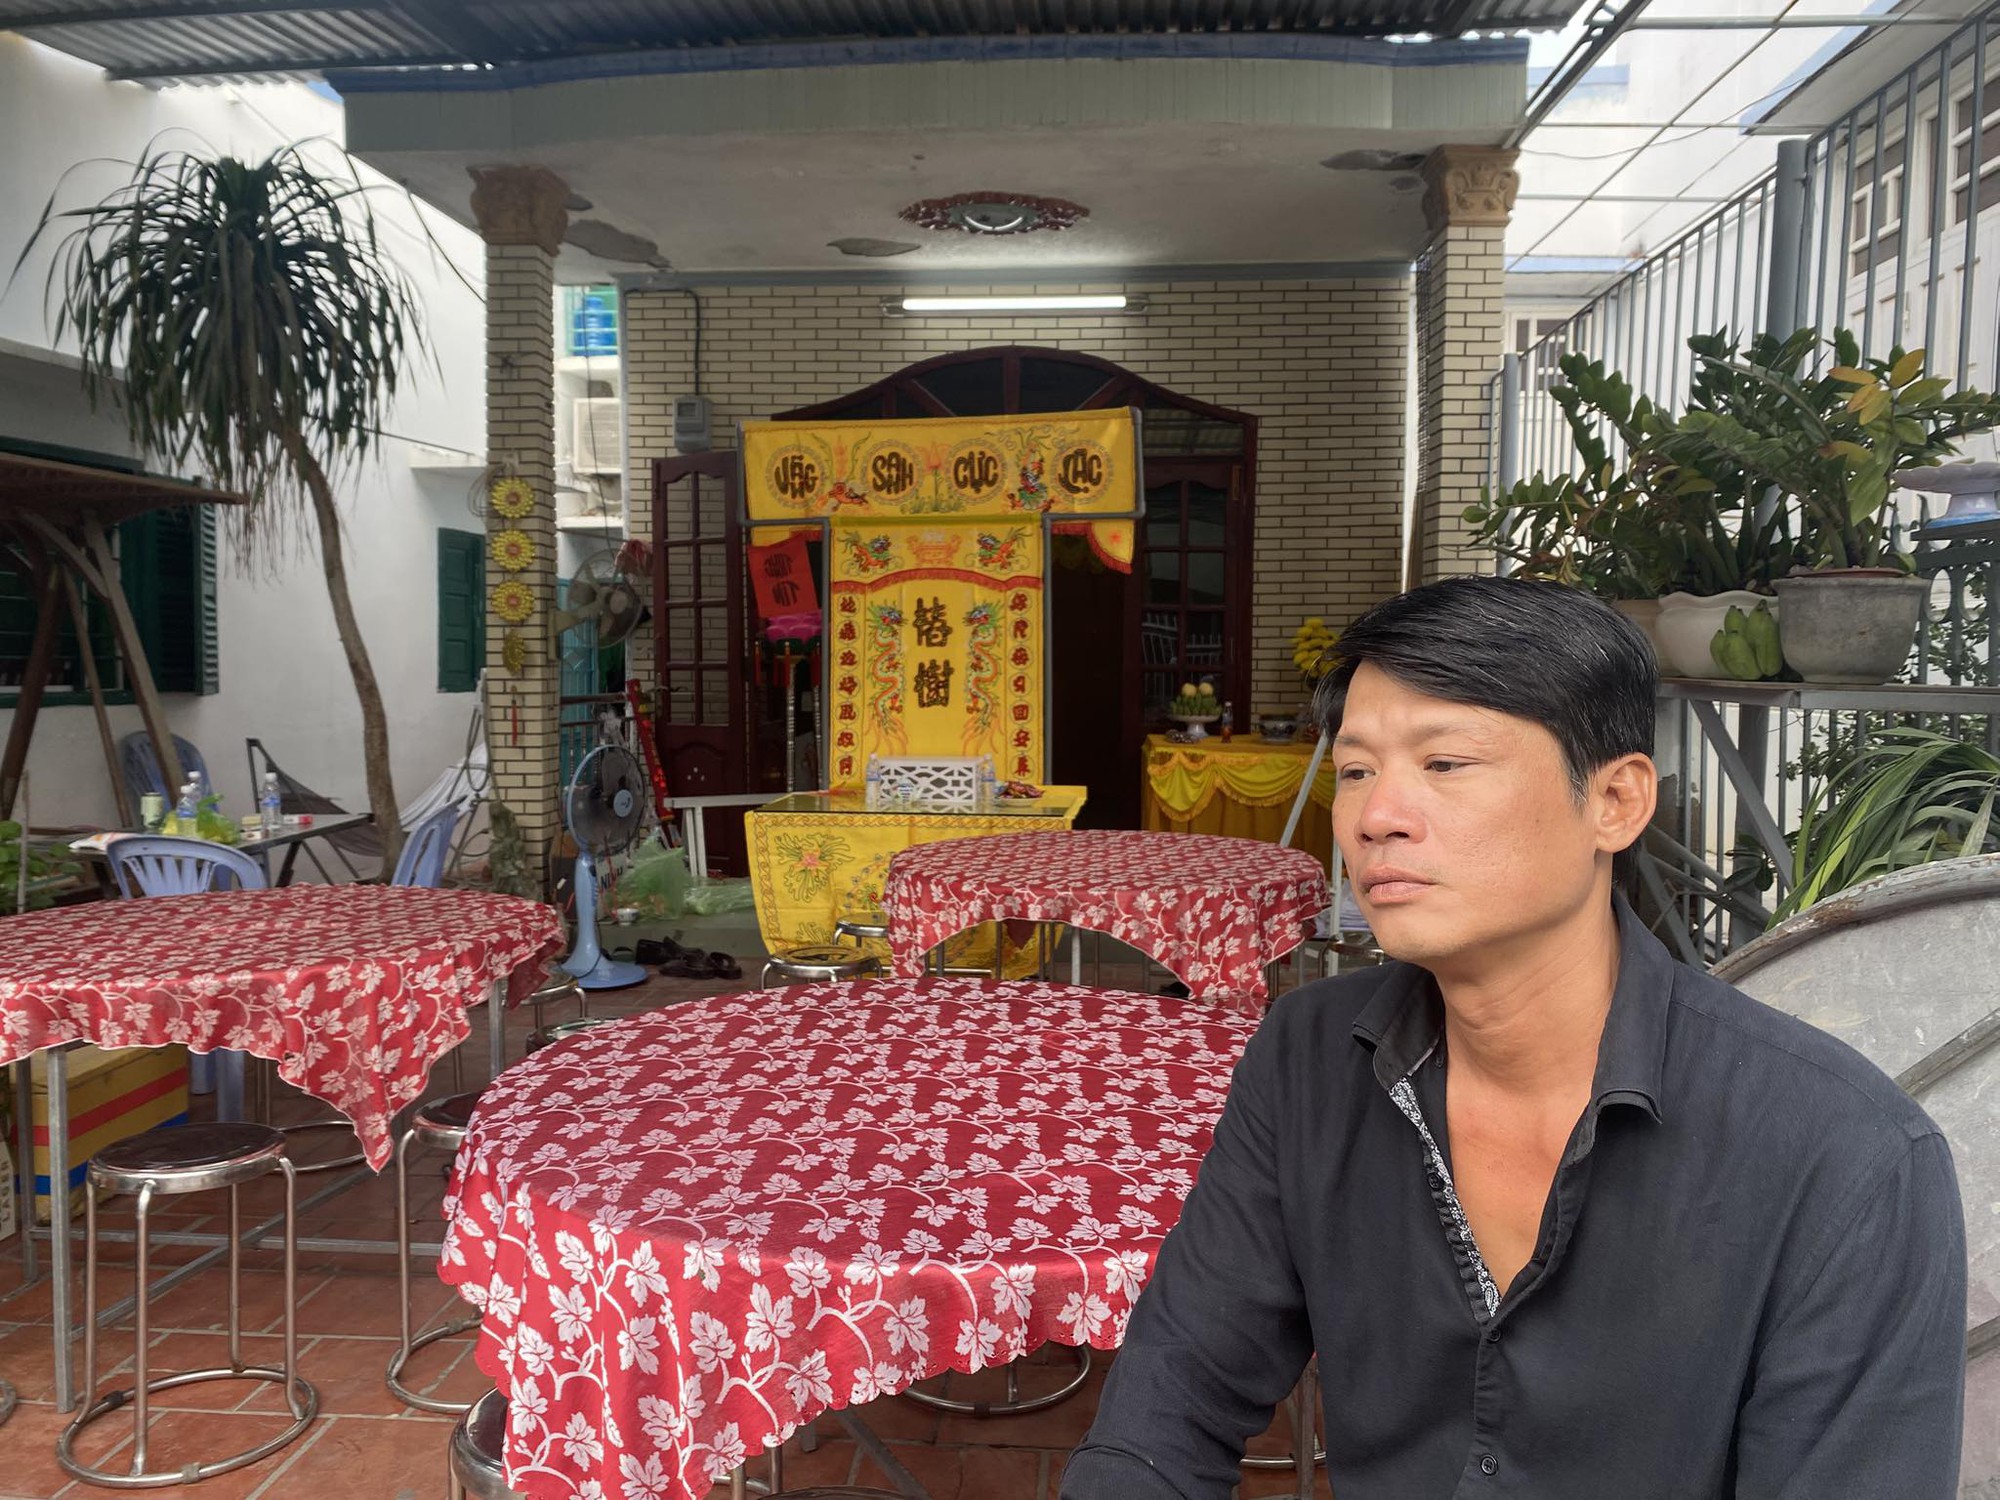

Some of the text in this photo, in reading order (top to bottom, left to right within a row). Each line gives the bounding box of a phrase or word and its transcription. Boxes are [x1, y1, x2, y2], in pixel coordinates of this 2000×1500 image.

[871, 451, 914, 494] SANH
[953, 450, 998, 493] CỰC
[1058, 449, 1103, 494] LẠC
